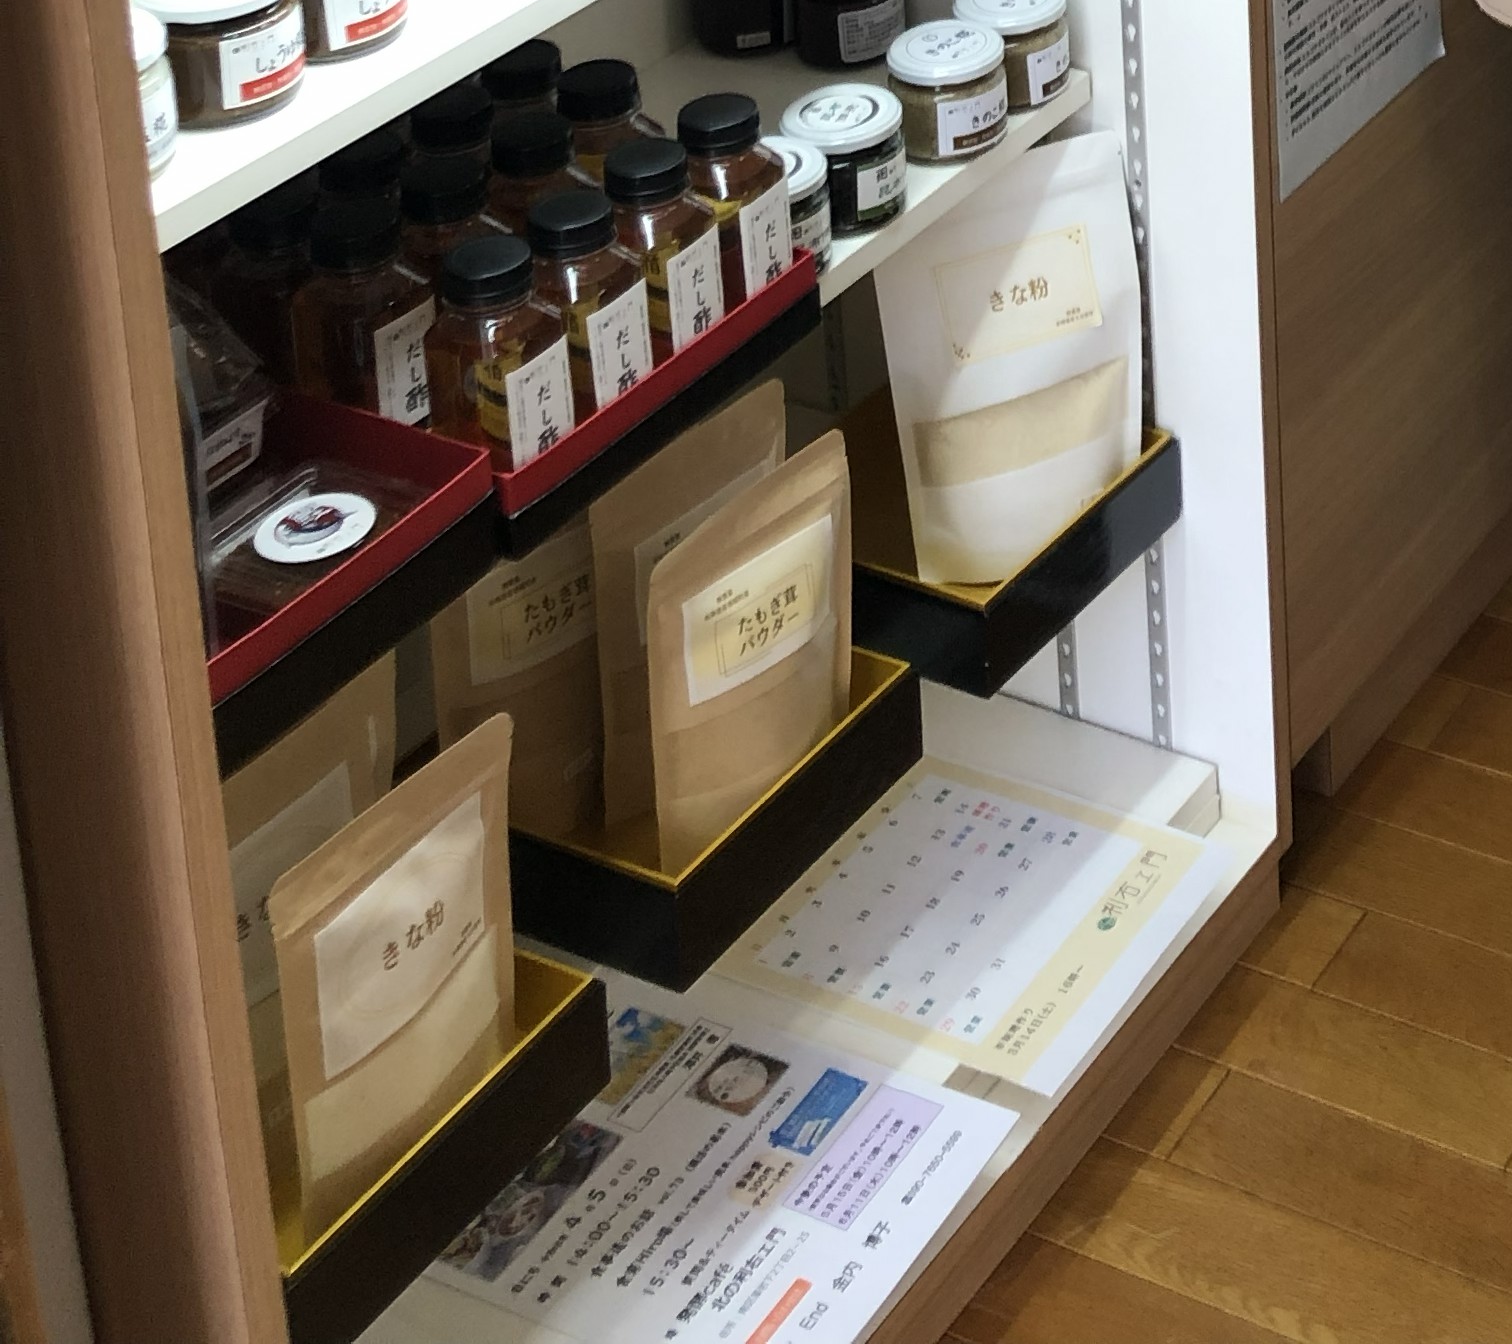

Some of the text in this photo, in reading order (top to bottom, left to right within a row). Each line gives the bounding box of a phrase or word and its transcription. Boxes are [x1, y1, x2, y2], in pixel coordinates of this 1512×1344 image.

[691, 267, 712, 335] だし酢
[990, 276, 1048, 312] きな粉
[737, 584, 799, 637] たもぎ茸
[739, 611, 800, 657] パウダー
[382, 899, 445, 971] きな粉
[799, 1302, 829, 1330] End
[832, 1261, 863, 1293] 金内
